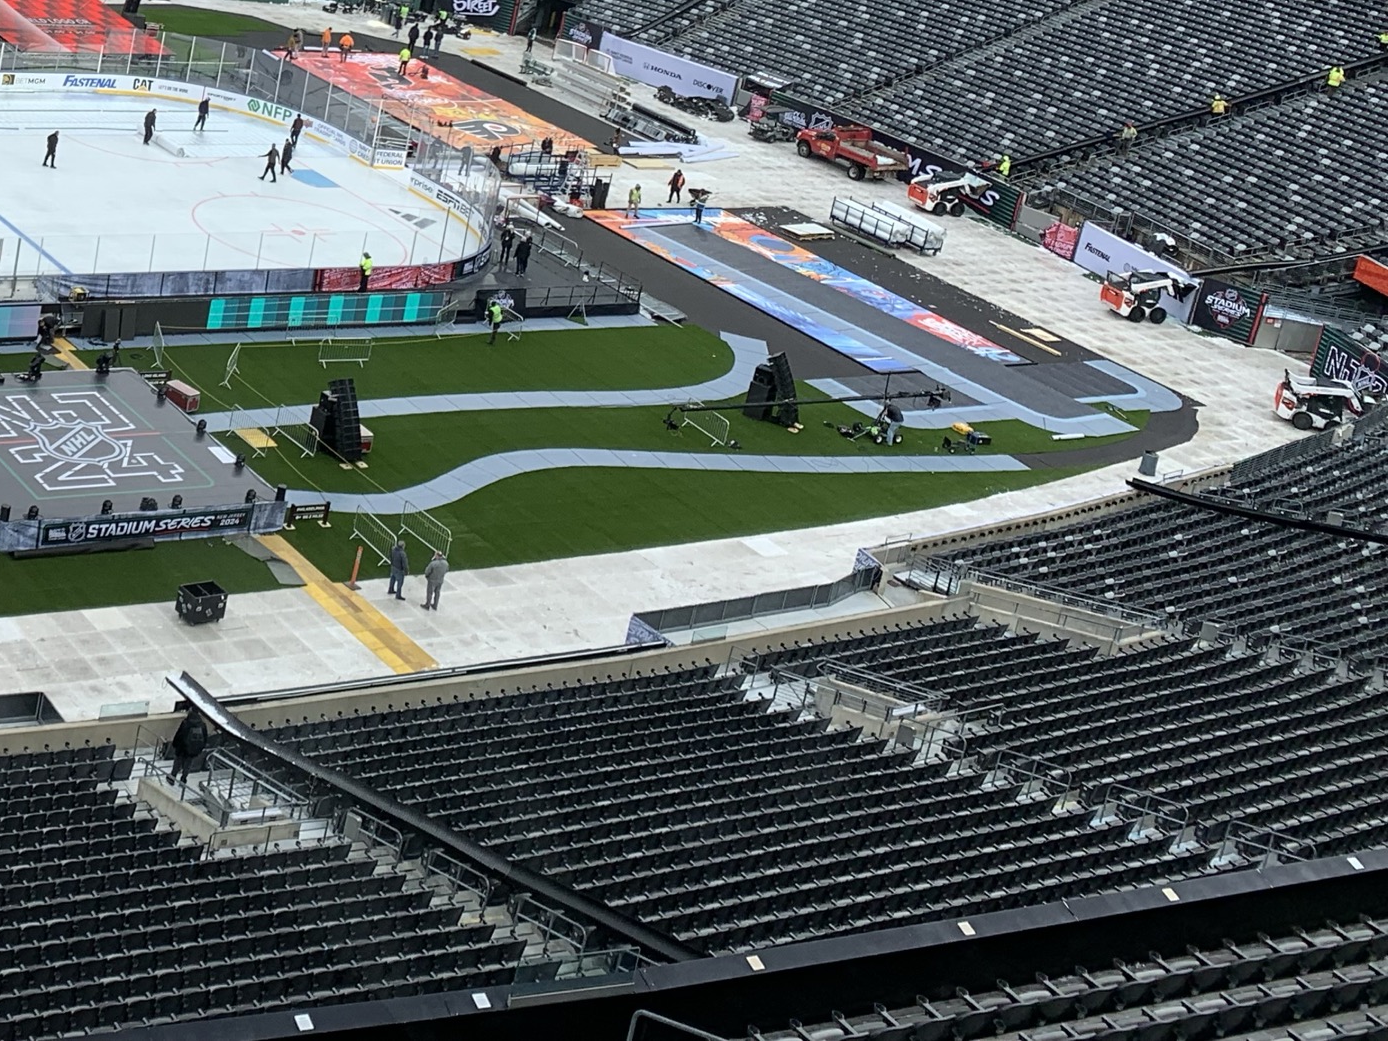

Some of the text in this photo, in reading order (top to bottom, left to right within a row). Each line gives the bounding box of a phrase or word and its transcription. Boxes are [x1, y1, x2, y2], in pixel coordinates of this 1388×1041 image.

[15, 77, 46, 85] BETMGM
[650, 65, 683, 81] HONDA
[63, 74, 117, 89] FASTENAL
[132, 78, 154, 91] CAT
[693, 79, 724, 95] DISCOVER
[262, 102, 293, 122] NFP
[376, 150, 404, 158] FEDERAL
[436, 188, 460, 210] ESPN
[1084, 242, 1111, 263] FASTENAL
[1204, 295, 1251, 318] STADIUM
[61, 430, 99, 458] NHL
[87, 519, 156, 539] STADIUM
[155, 515, 215, 532] SERIES
[219, 517, 240, 526] 2024
